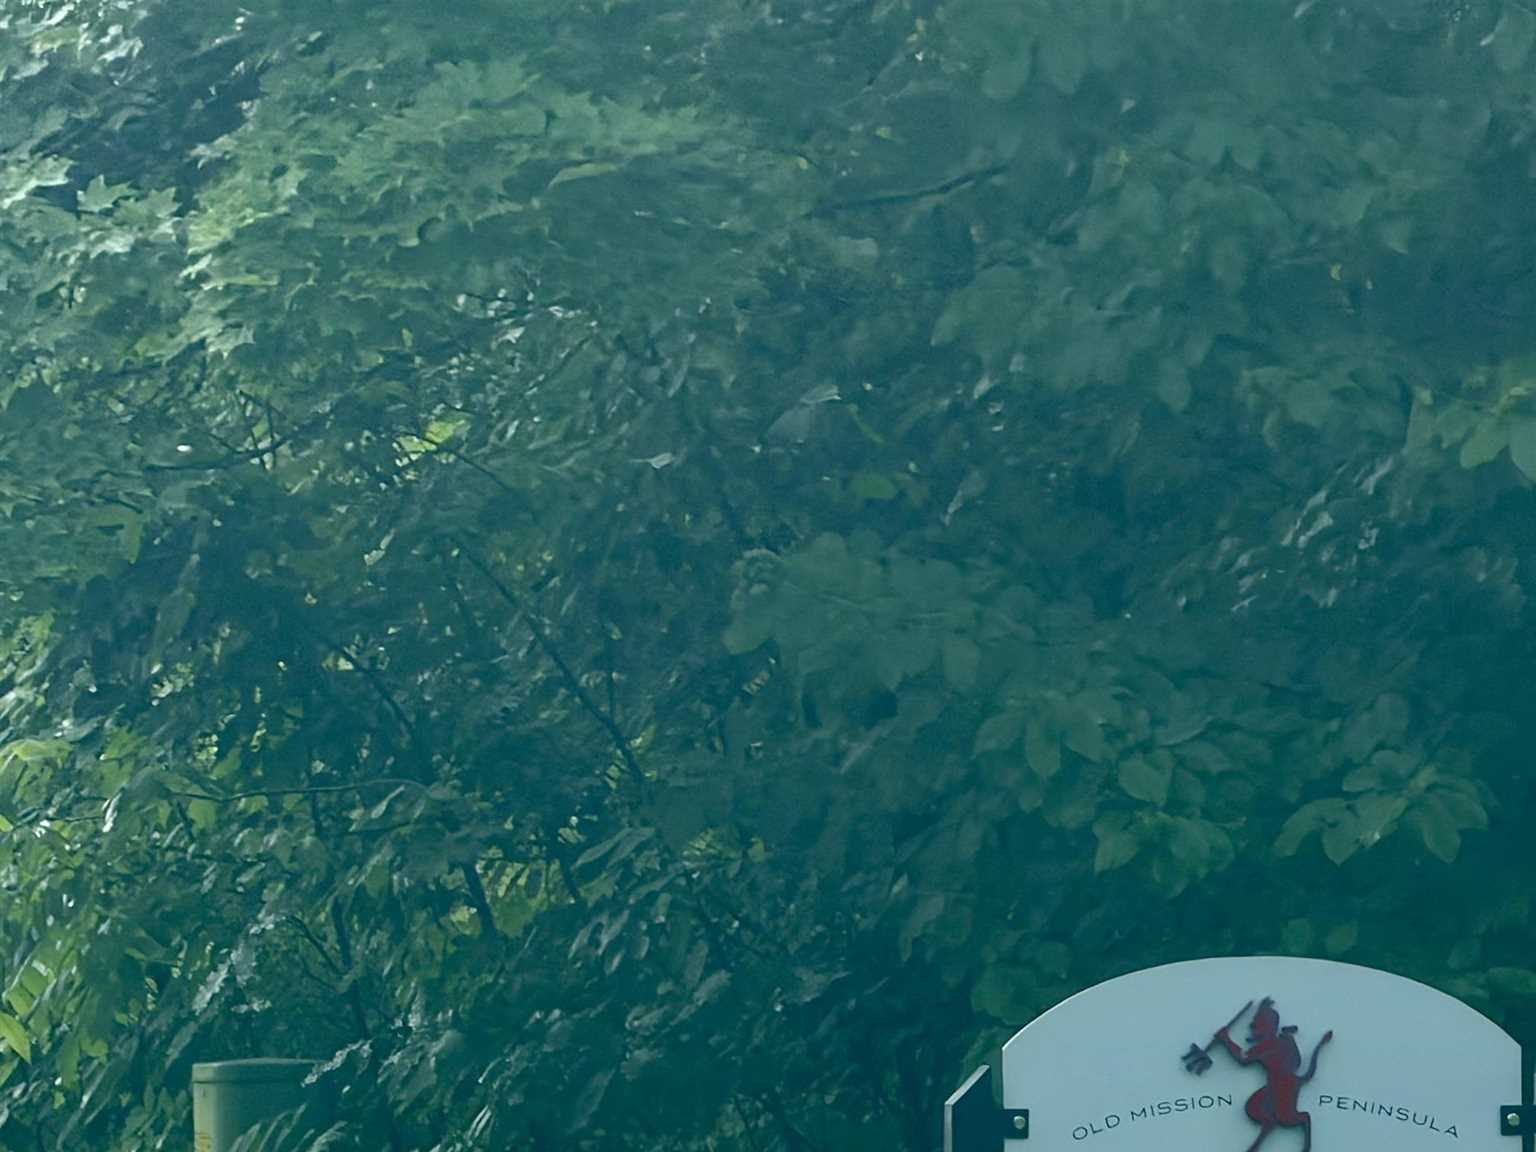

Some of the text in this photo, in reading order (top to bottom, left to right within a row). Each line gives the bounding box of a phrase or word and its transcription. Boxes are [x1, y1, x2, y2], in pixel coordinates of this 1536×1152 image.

[1072, 1094, 1459, 1141] OLD MISSION PENINSULA
